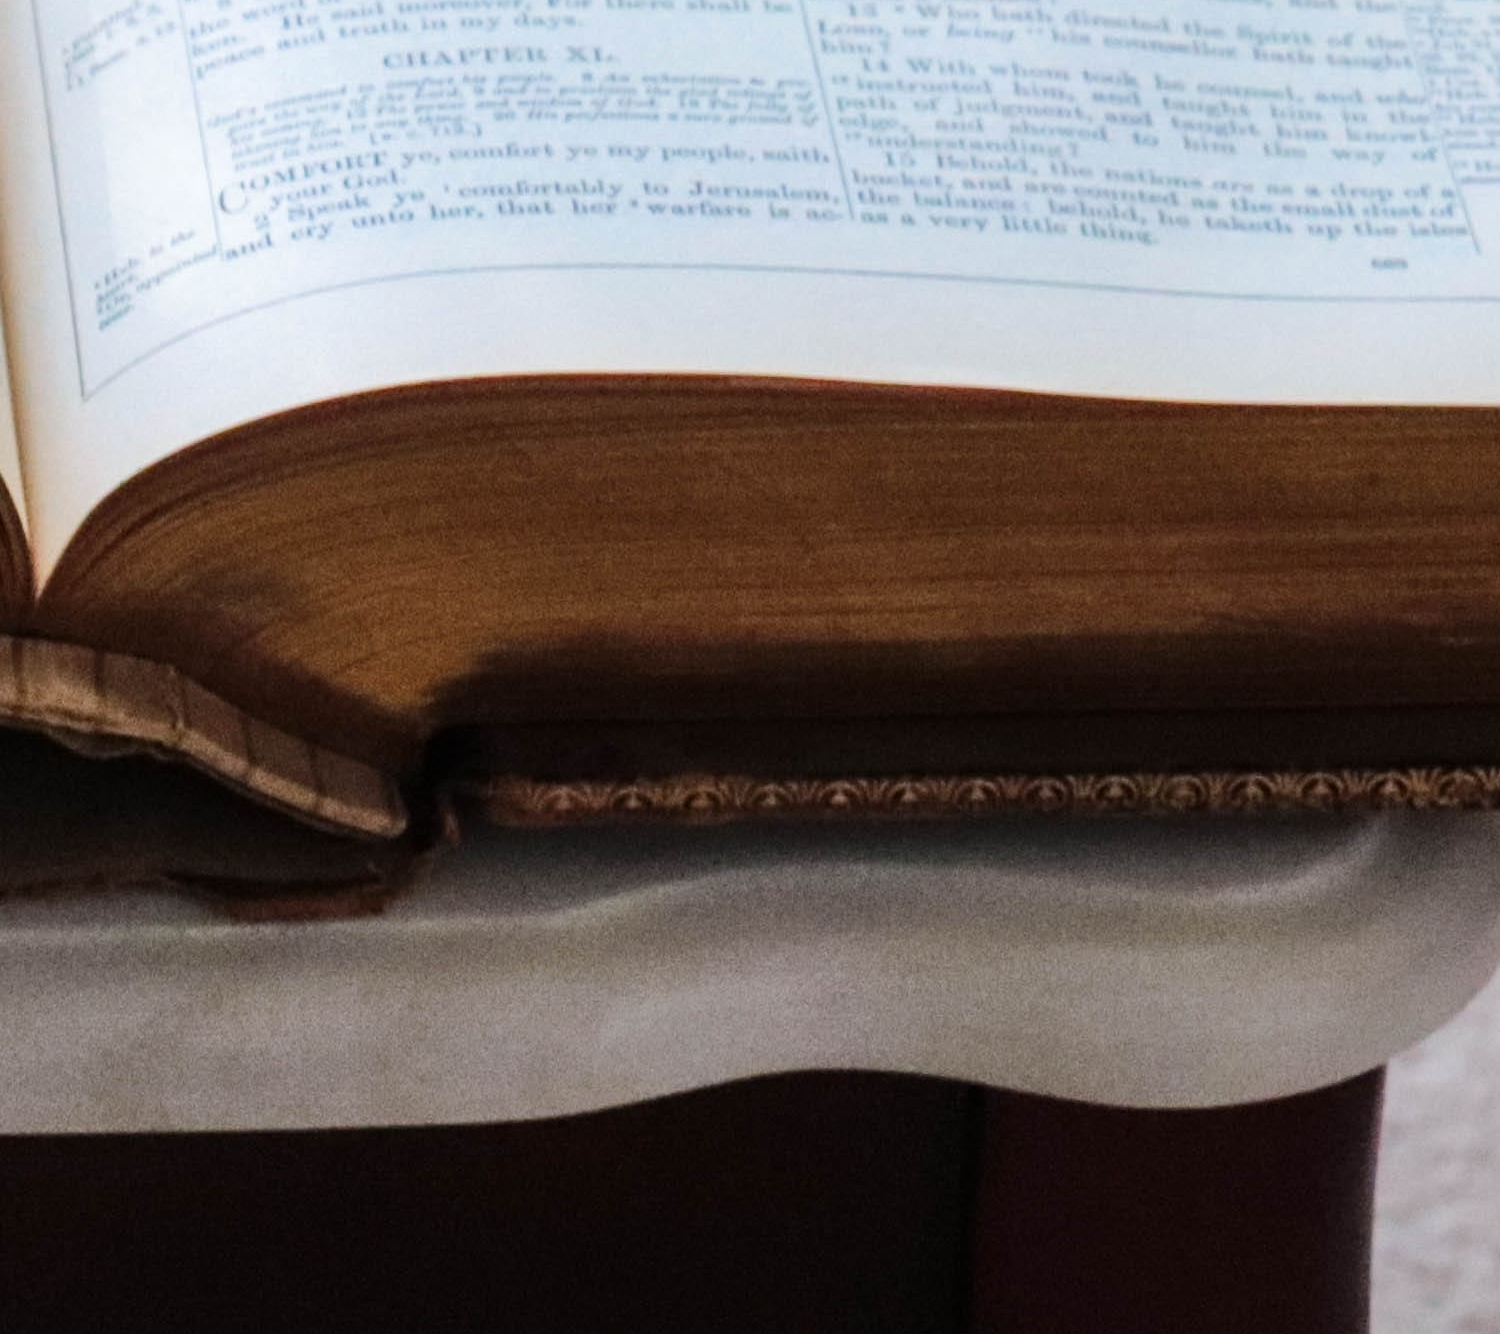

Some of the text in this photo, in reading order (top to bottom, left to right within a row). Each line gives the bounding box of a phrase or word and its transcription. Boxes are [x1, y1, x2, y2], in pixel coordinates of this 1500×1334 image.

[383, 45, 547, 67] CHAPTER
[450, 142, 553, 160] comfort
[568, 146, 598, 161] ye
[608, 144, 650, 161] my
[763, 148, 830, 164] saith
[270, 183, 330, 211] your
[288, 192, 370, 222] Speak
[392, 191, 425, 208] ye
[643, 181, 668, 196] to
[689, 180, 840, 205] Jerusalem,
[224, 233, 274, 261] and
[291, 222, 333, 241] cry
[352, 209, 414, 228] unto
[430, 204, 484, 220] her,
[498, 200, 554, 217] that
[572, 199, 618, 216] her
[769, 202, 790, 220] is
[858, 191, 899, 205] the
[1158, 210, 1190, 227] he
[1205, 216, 1293, 235] taketh
[1308, 224, 1342, 242] up
[1354, 222, 1397, 236] the
[861, 211, 889, 224] as
[901, 214, 915, 226] a
[930, 216, 988, 232] very
[1002, 216, 1067, 235] little
